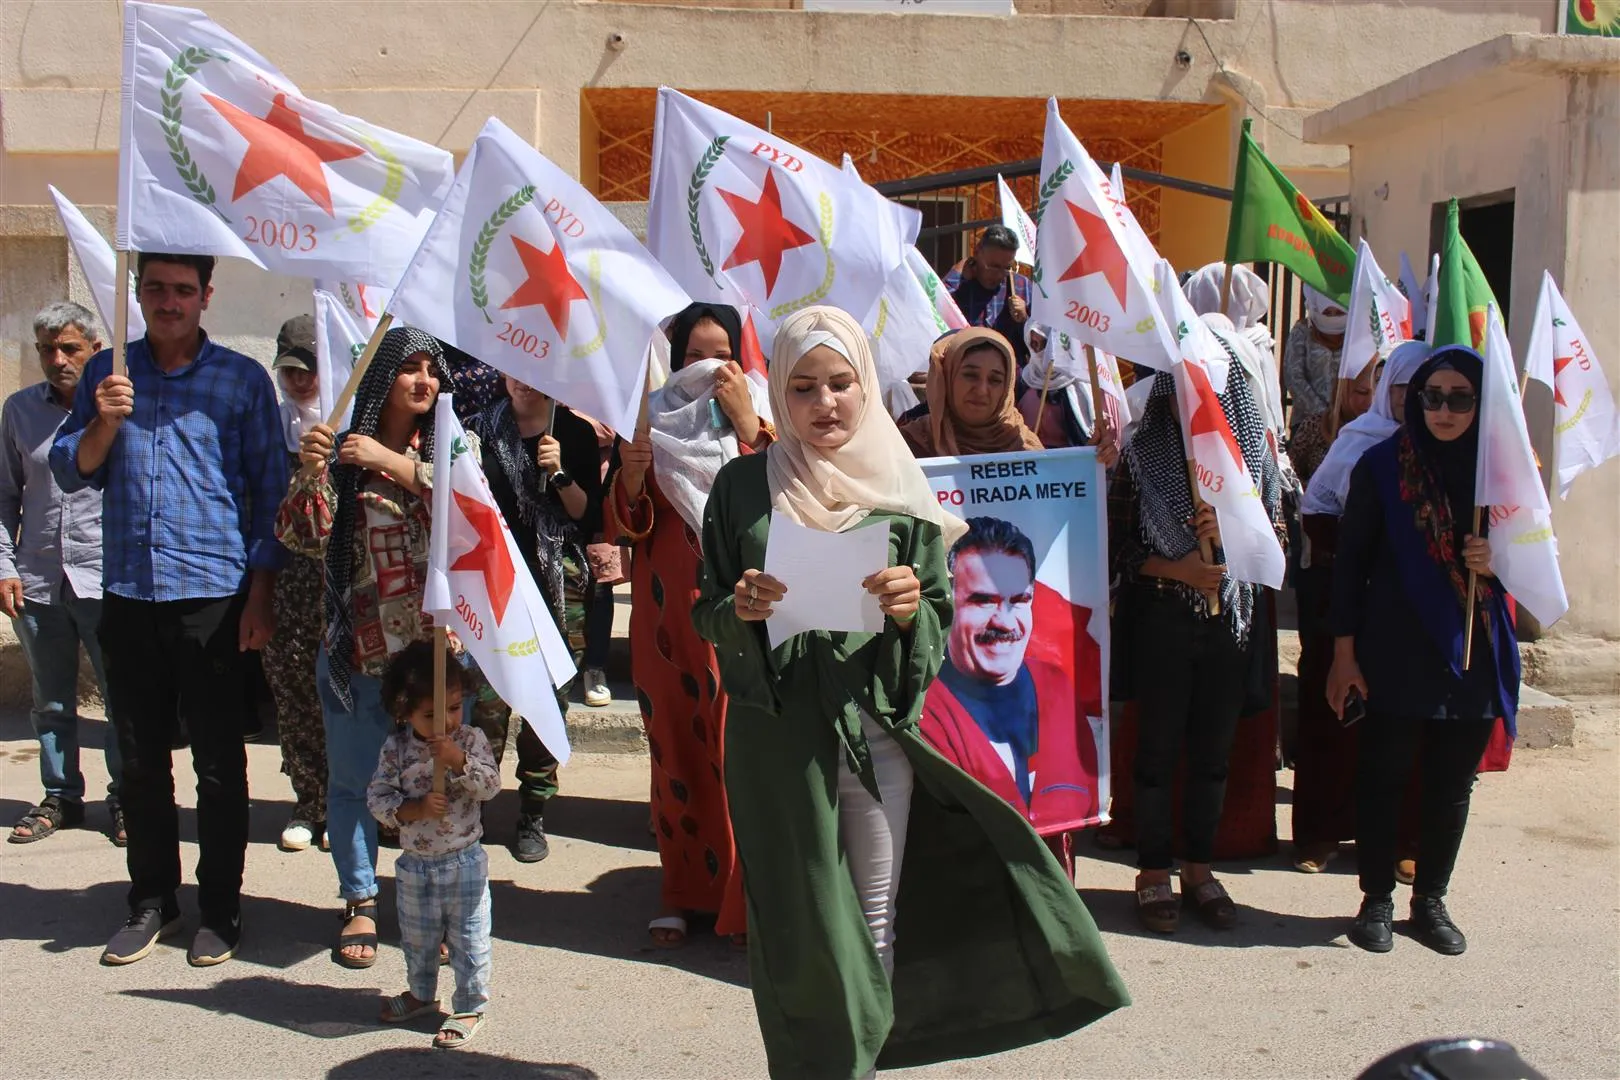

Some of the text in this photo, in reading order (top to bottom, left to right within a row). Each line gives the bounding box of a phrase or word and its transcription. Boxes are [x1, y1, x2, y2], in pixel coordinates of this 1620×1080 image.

[750, 143, 803, 172] PYD
[244, 216, 317, 252] 2003
[543, 198, 584, 237] PYD
[1064, 300, 1111, 333] 2003
[496, 321, 549, 359] 2003
[1570, 339, 1591, 371] PYD
[970, 485, 1032, 504] IRADA
[1035, 481, 1087, 500] MEYE
[1194, 463, 1224, 493] 003
[455, 594, 484, 641] 2003
